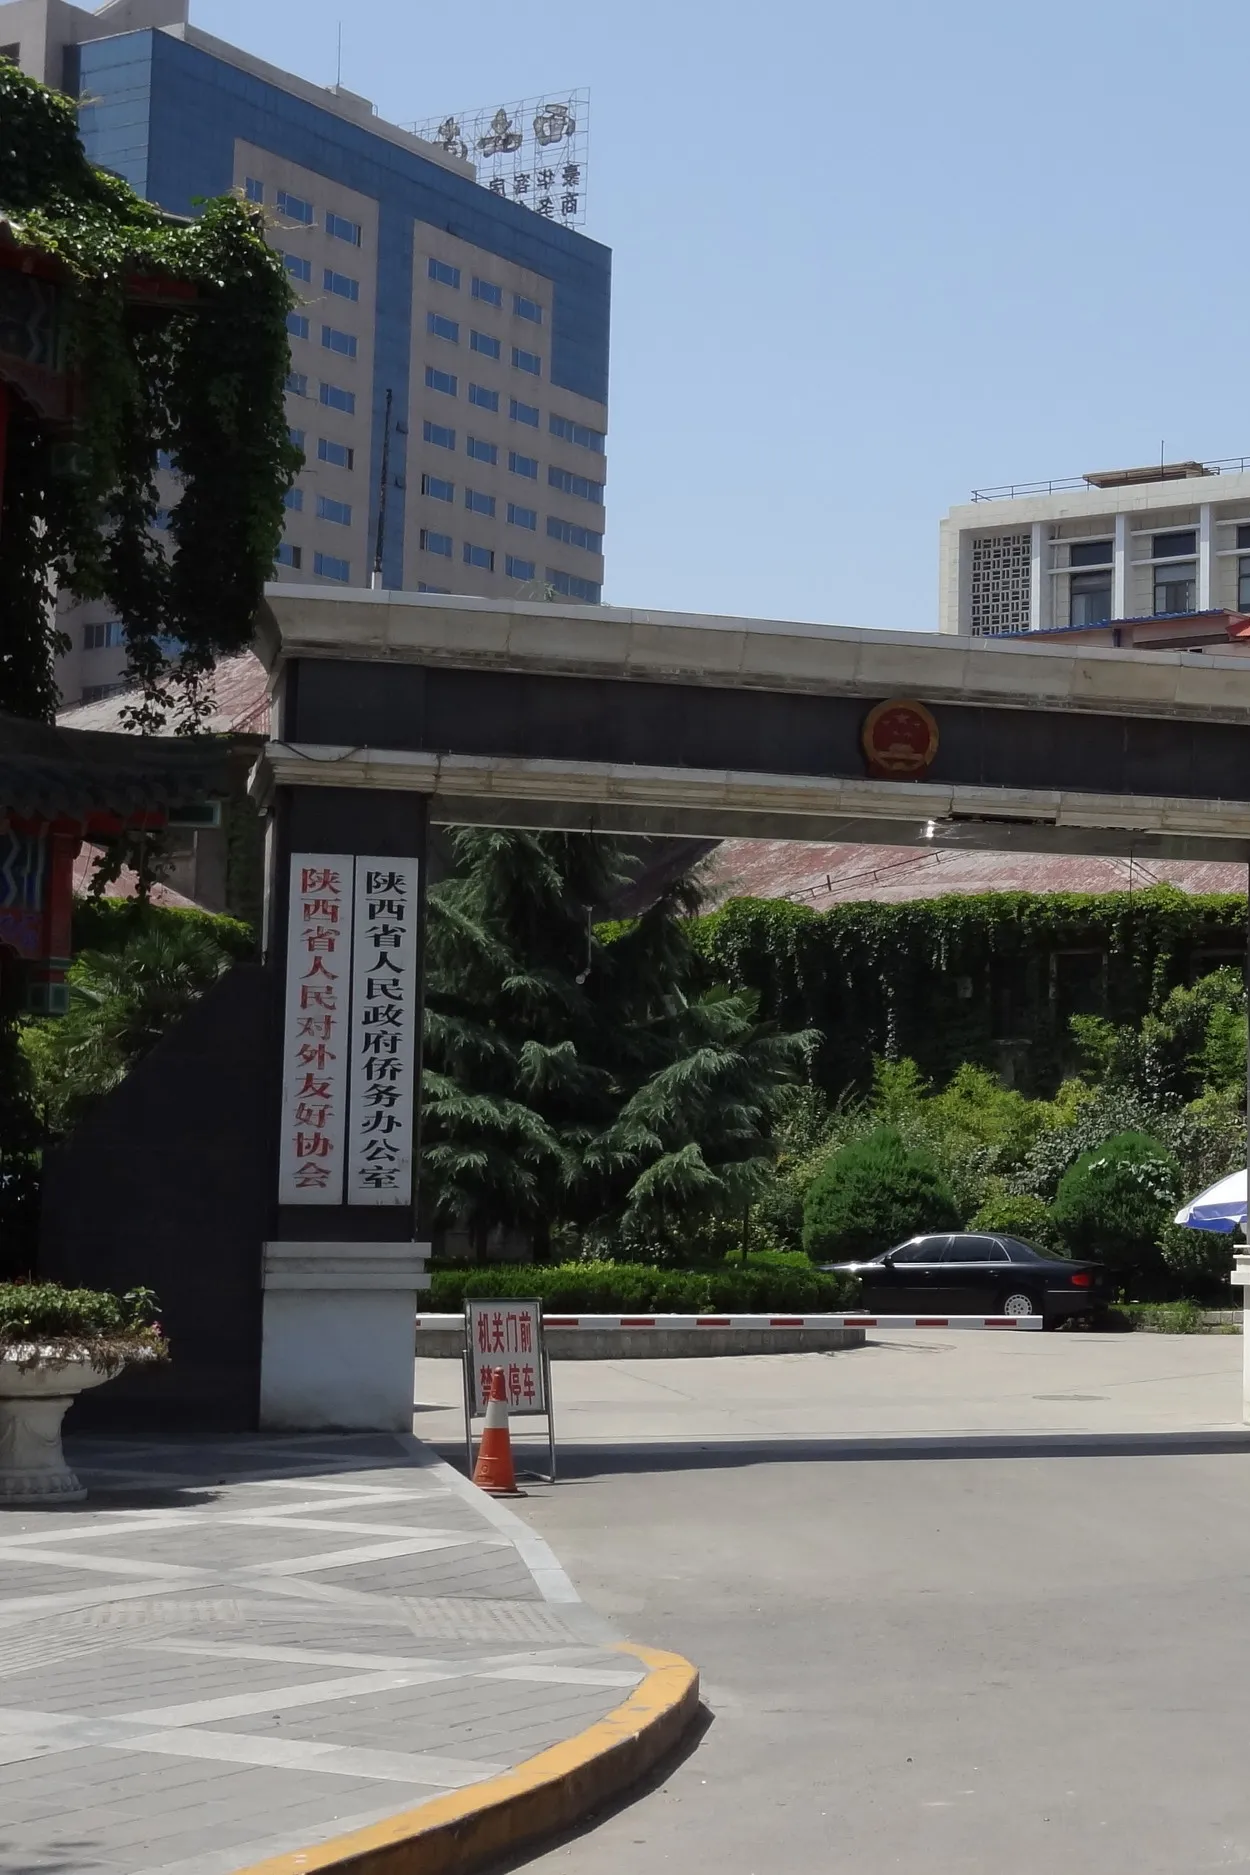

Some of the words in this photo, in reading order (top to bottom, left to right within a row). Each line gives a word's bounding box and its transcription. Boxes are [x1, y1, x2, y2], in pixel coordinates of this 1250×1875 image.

[292, 867, 342, 1189] 陕西省人民对外友好协会
[358, 871, 407, 1189] 陕西省人民政府侨务办公室
[478, 1311, 532, 1354] 机关门前
[480, 1362, 535, 1406] 禁停车
